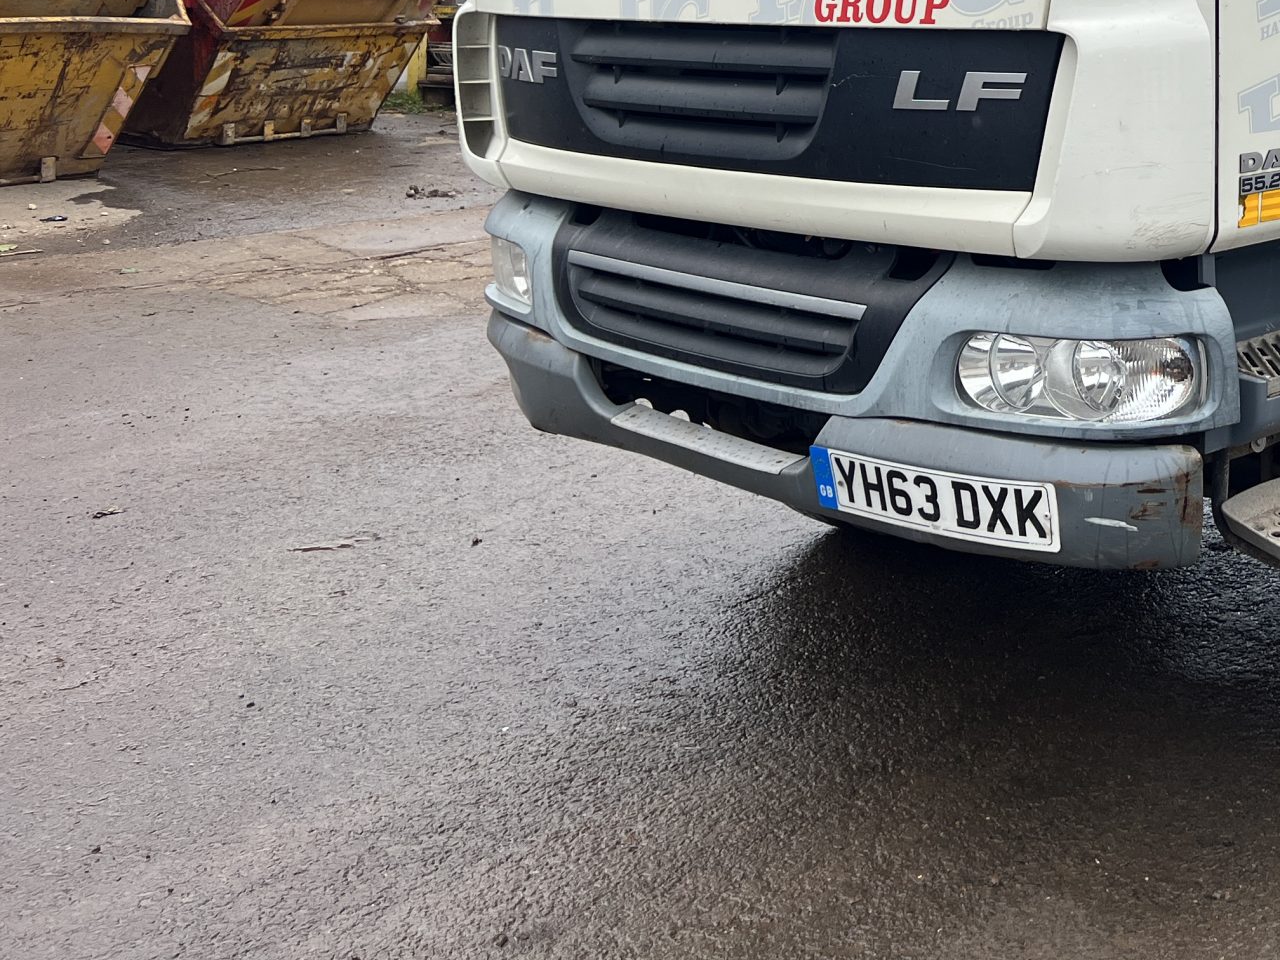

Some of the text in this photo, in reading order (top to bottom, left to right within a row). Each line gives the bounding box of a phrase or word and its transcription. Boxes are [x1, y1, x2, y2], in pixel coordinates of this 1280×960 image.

[498, 44, 559, 84] DAF
[892, 69, 1028, 112] LF
[819, 484, 834, 499] GB
[833, 457, 1048, 539] YH63 DXK
